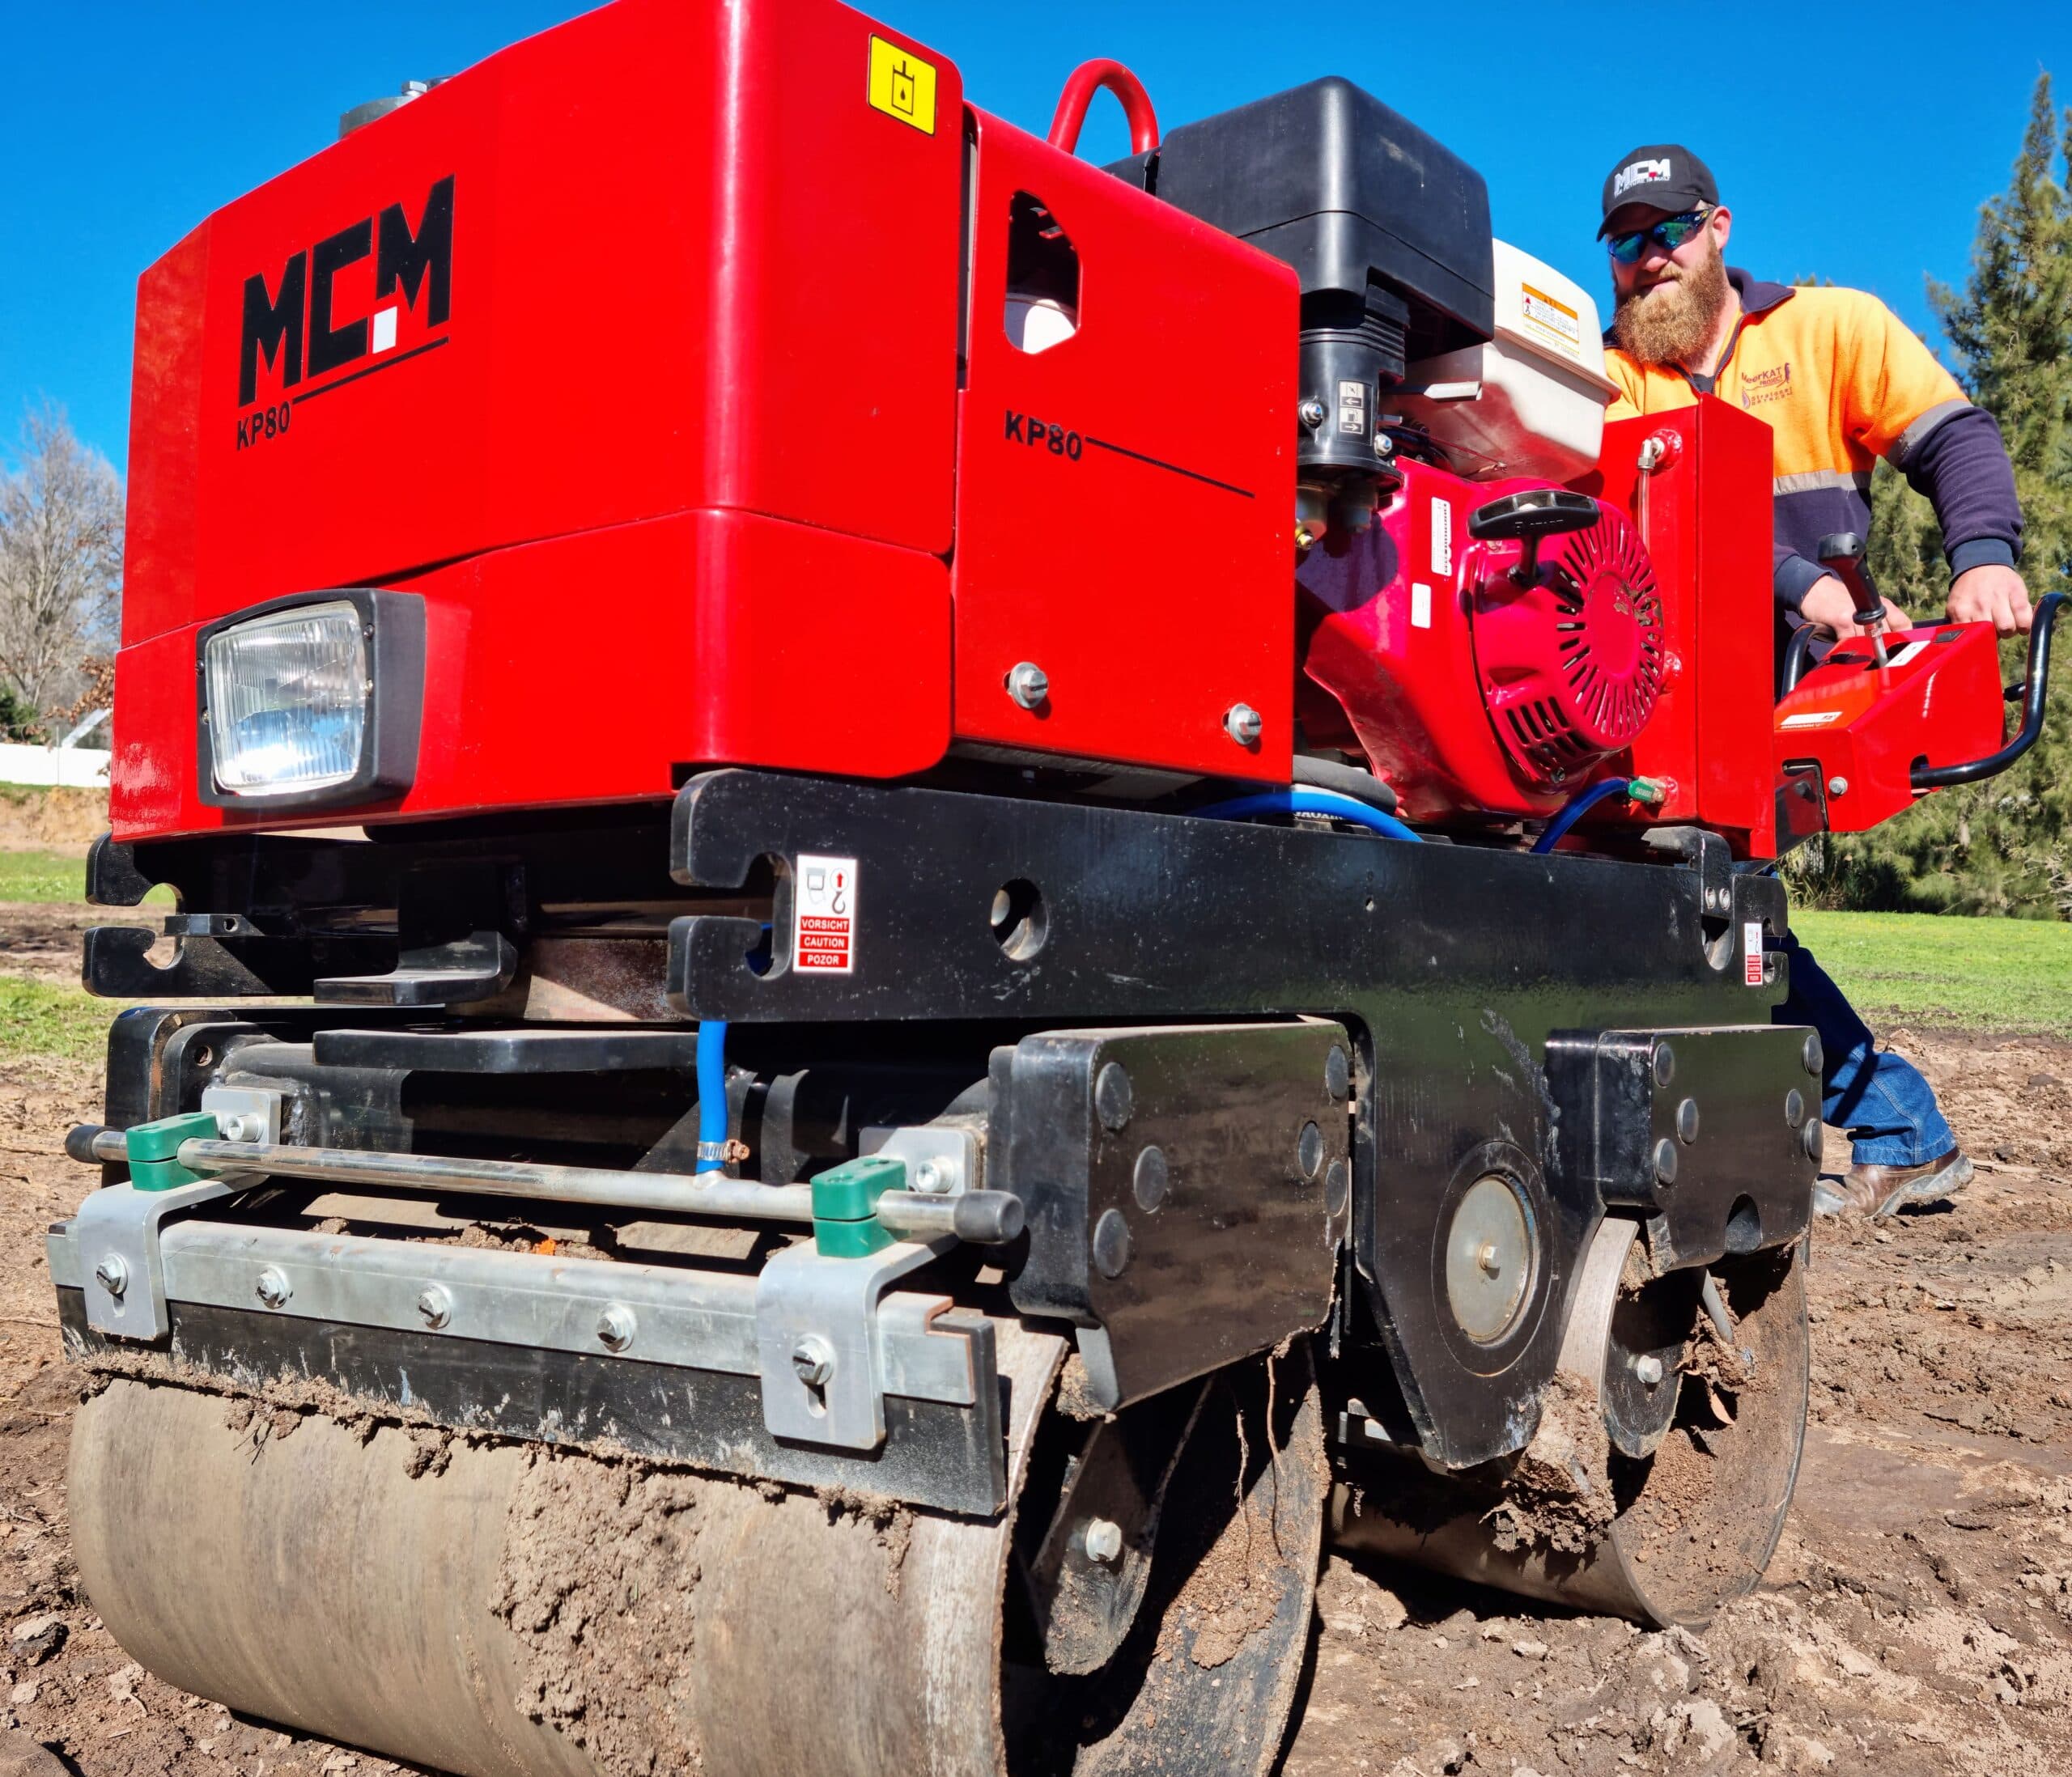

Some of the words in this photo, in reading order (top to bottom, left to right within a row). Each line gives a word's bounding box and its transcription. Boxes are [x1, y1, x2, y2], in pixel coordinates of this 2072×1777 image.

[1615, 159, 1671, 194] MCM
[238, 172, 456, 409] MCM
[236, 401, 291, 452] KP80
[1005, 409, 1082, 461] KP80
[801, 918, 849, 930] VORSICHT
[804, 936, 844, 948] CAUTION
[807, 955, 839, 965] POZOR
